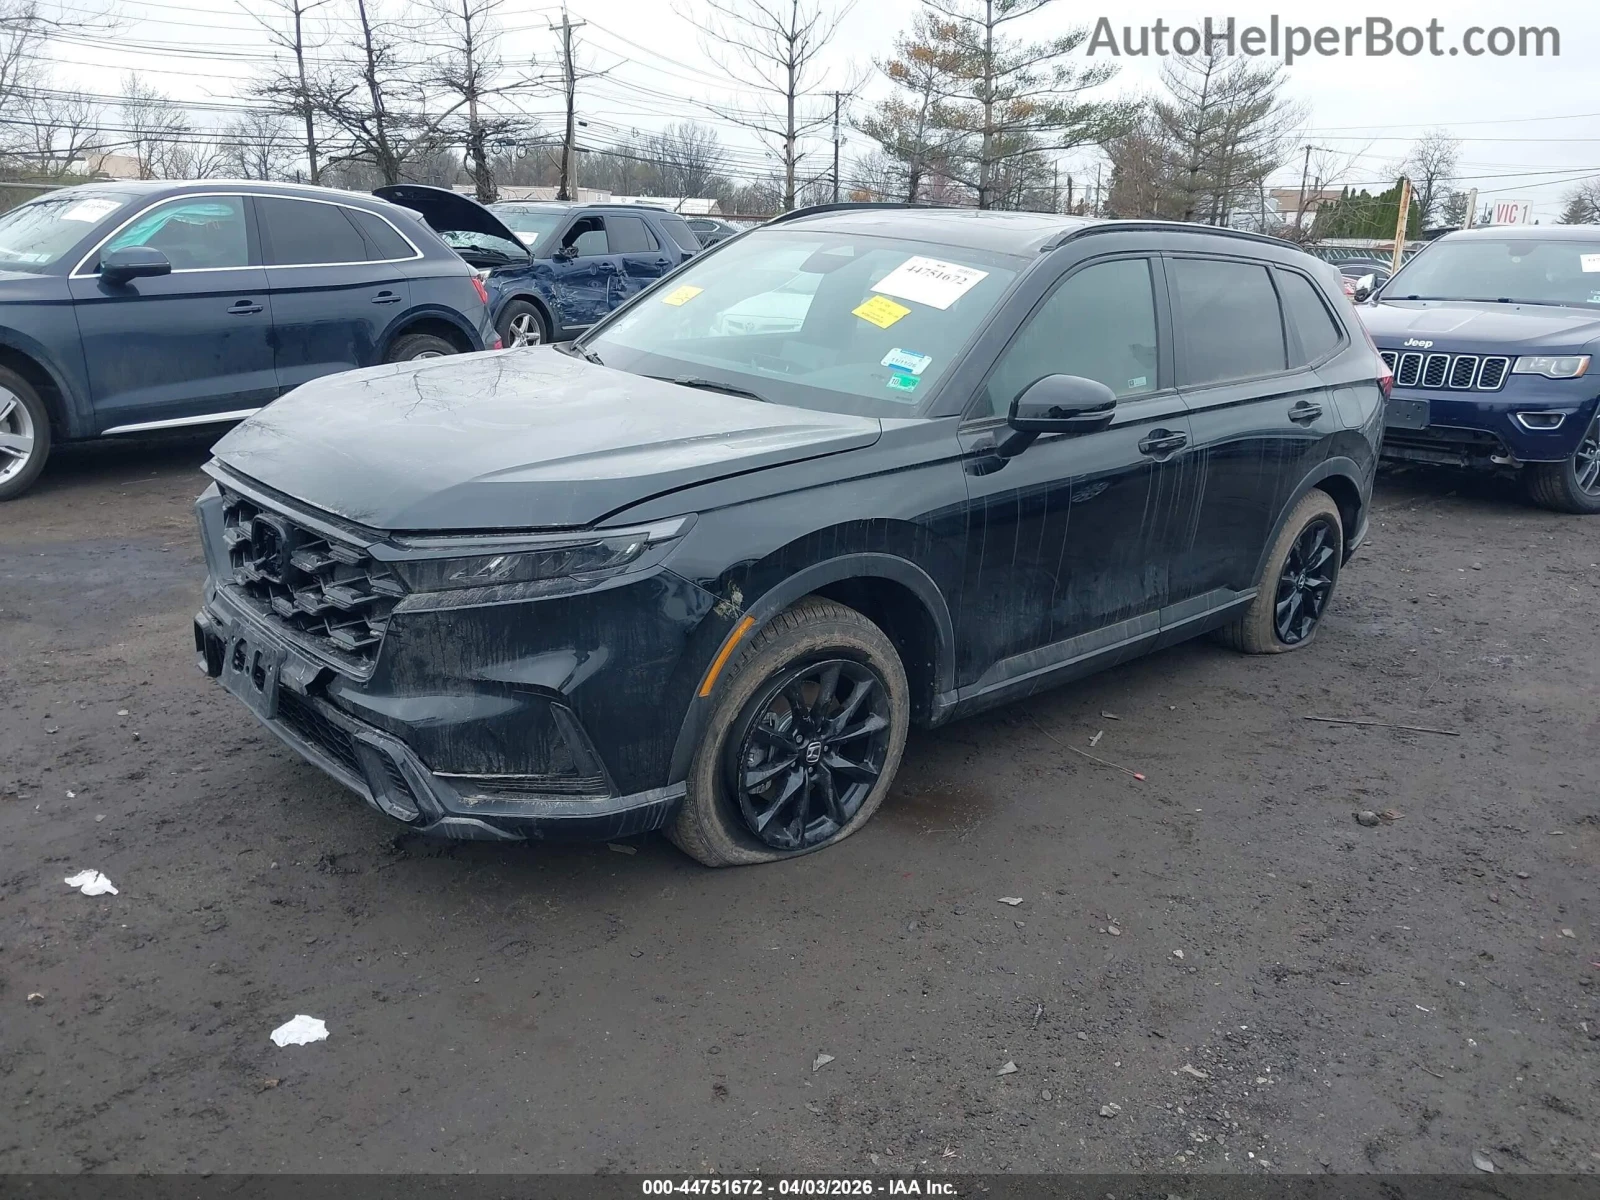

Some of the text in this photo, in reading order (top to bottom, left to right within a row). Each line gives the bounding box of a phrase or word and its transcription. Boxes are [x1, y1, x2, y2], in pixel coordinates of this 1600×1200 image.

[1497, 203, 1528, 224] VIC 1
[905, 265, 968, 285] 44751672
[1404, 338, 1433, 349] Jeep
